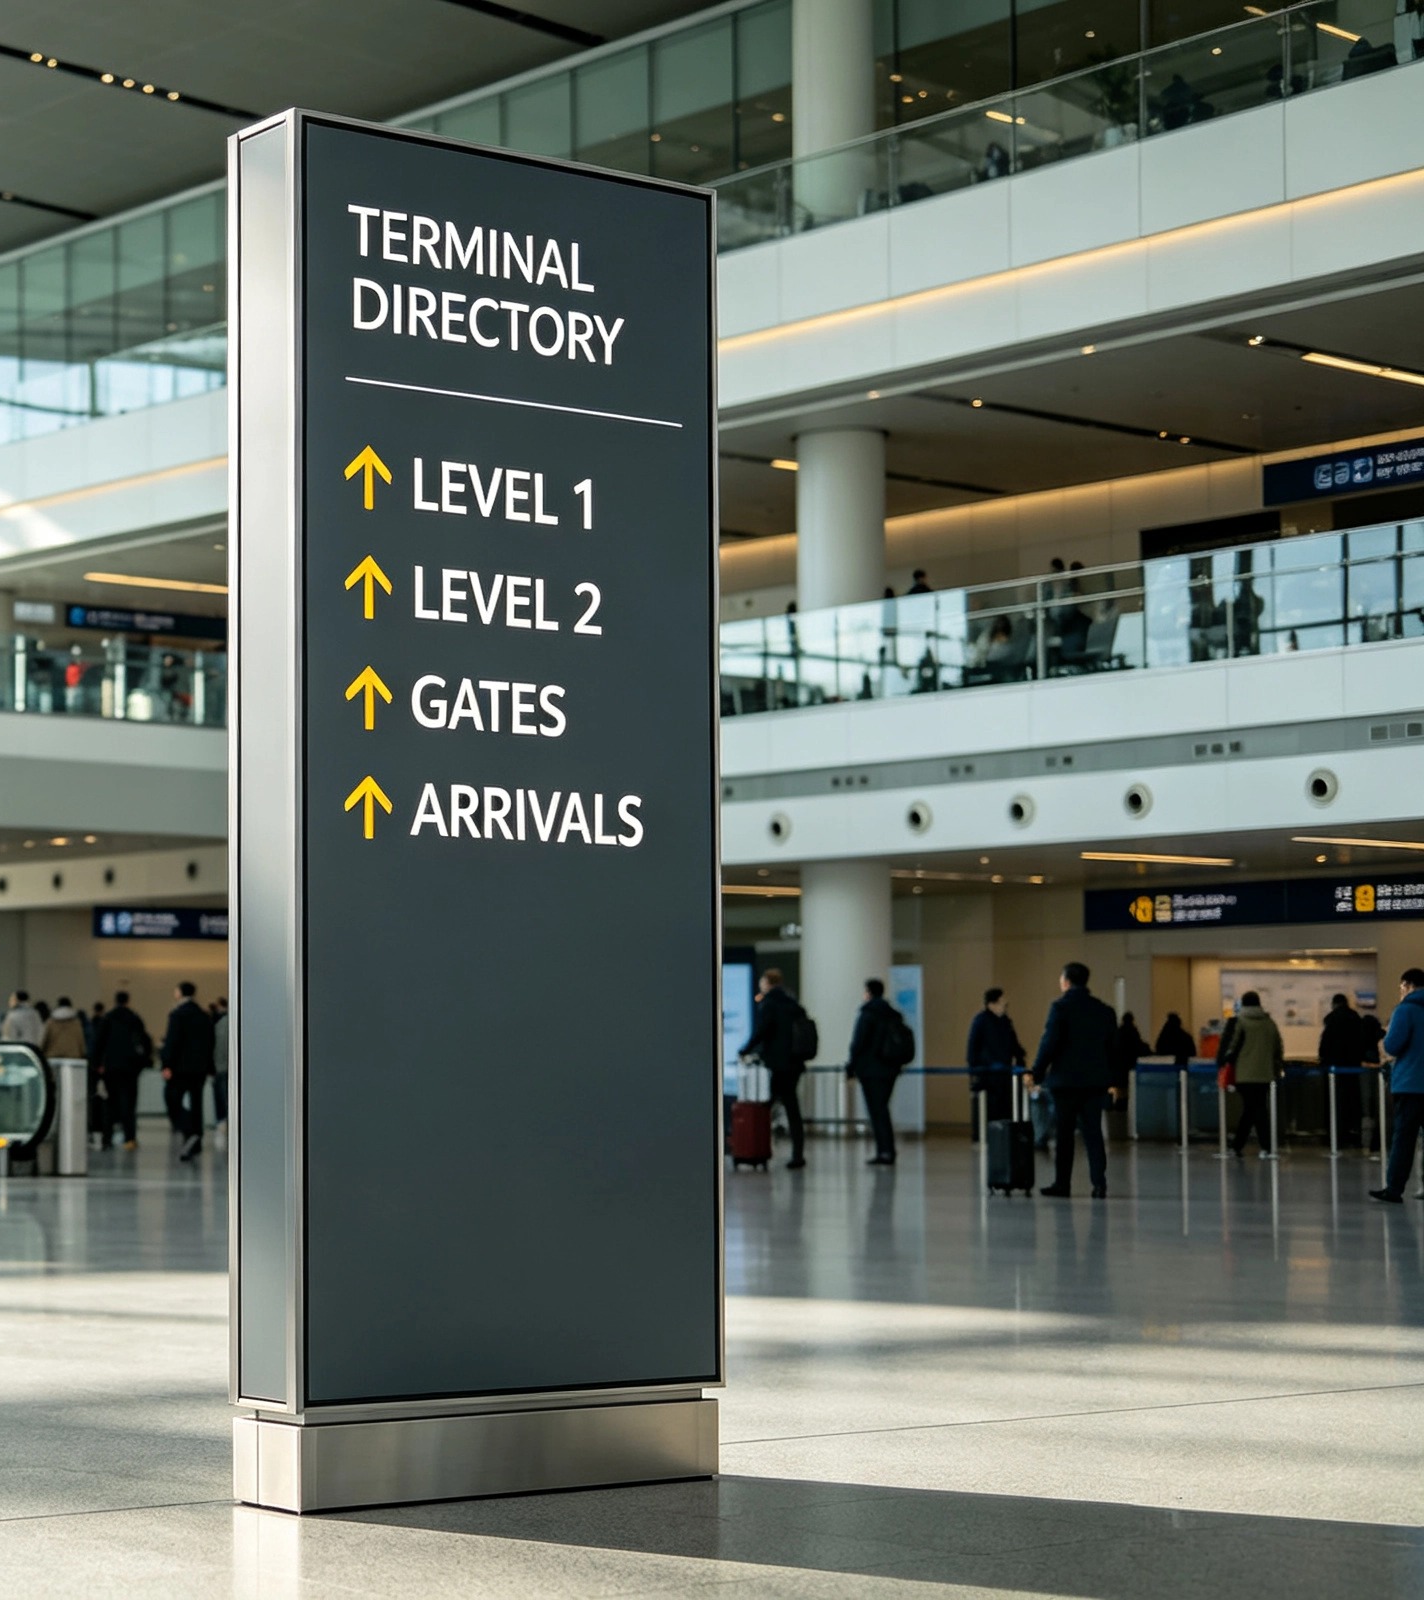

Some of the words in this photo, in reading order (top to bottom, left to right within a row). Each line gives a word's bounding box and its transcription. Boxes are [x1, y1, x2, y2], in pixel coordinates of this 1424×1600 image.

[348, 204, 594, 292] TERMINAL
[353, 278, 624, 365] DIRECTORY
[414, 458, 558, 525] LEVEL
[573, 478, 593, 530] 1
[414, 566, 559, 631] LEVEL
[573, 581, 603, 635] 2
[411, 675, 566, 738] GATES
[410, 783, 644, 848] ARRIVALS
